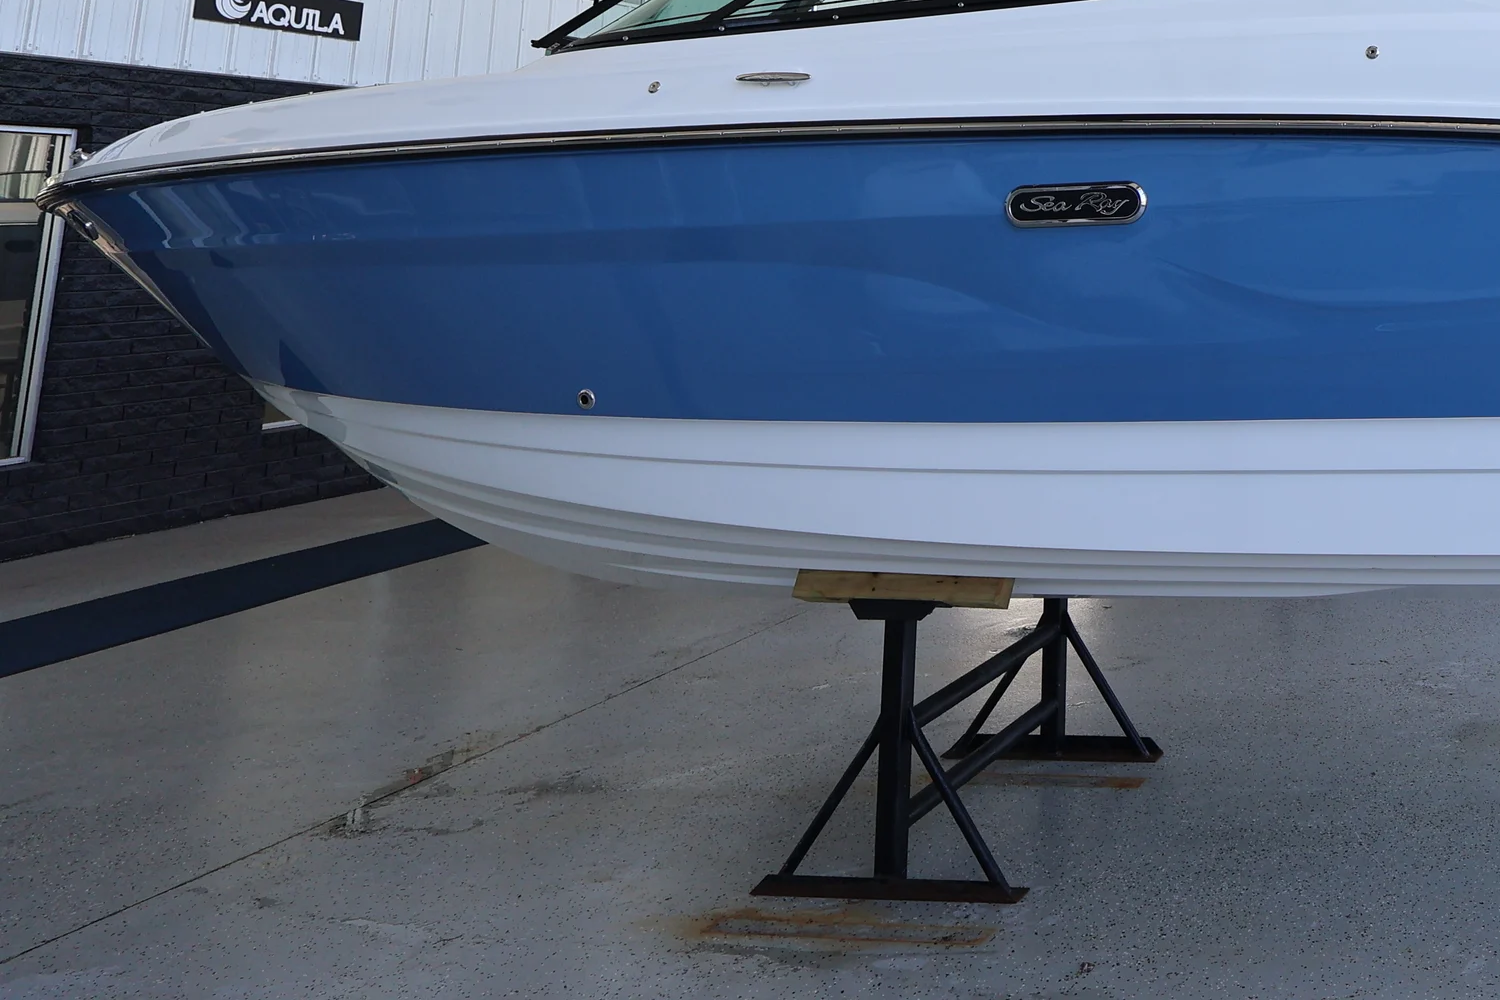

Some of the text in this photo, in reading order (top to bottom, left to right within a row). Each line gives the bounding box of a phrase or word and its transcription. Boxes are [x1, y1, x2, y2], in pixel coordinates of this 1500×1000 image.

[250, 1, 345, 35] AQUILA
[1019, 191, 1130, 216] Sea Ray
